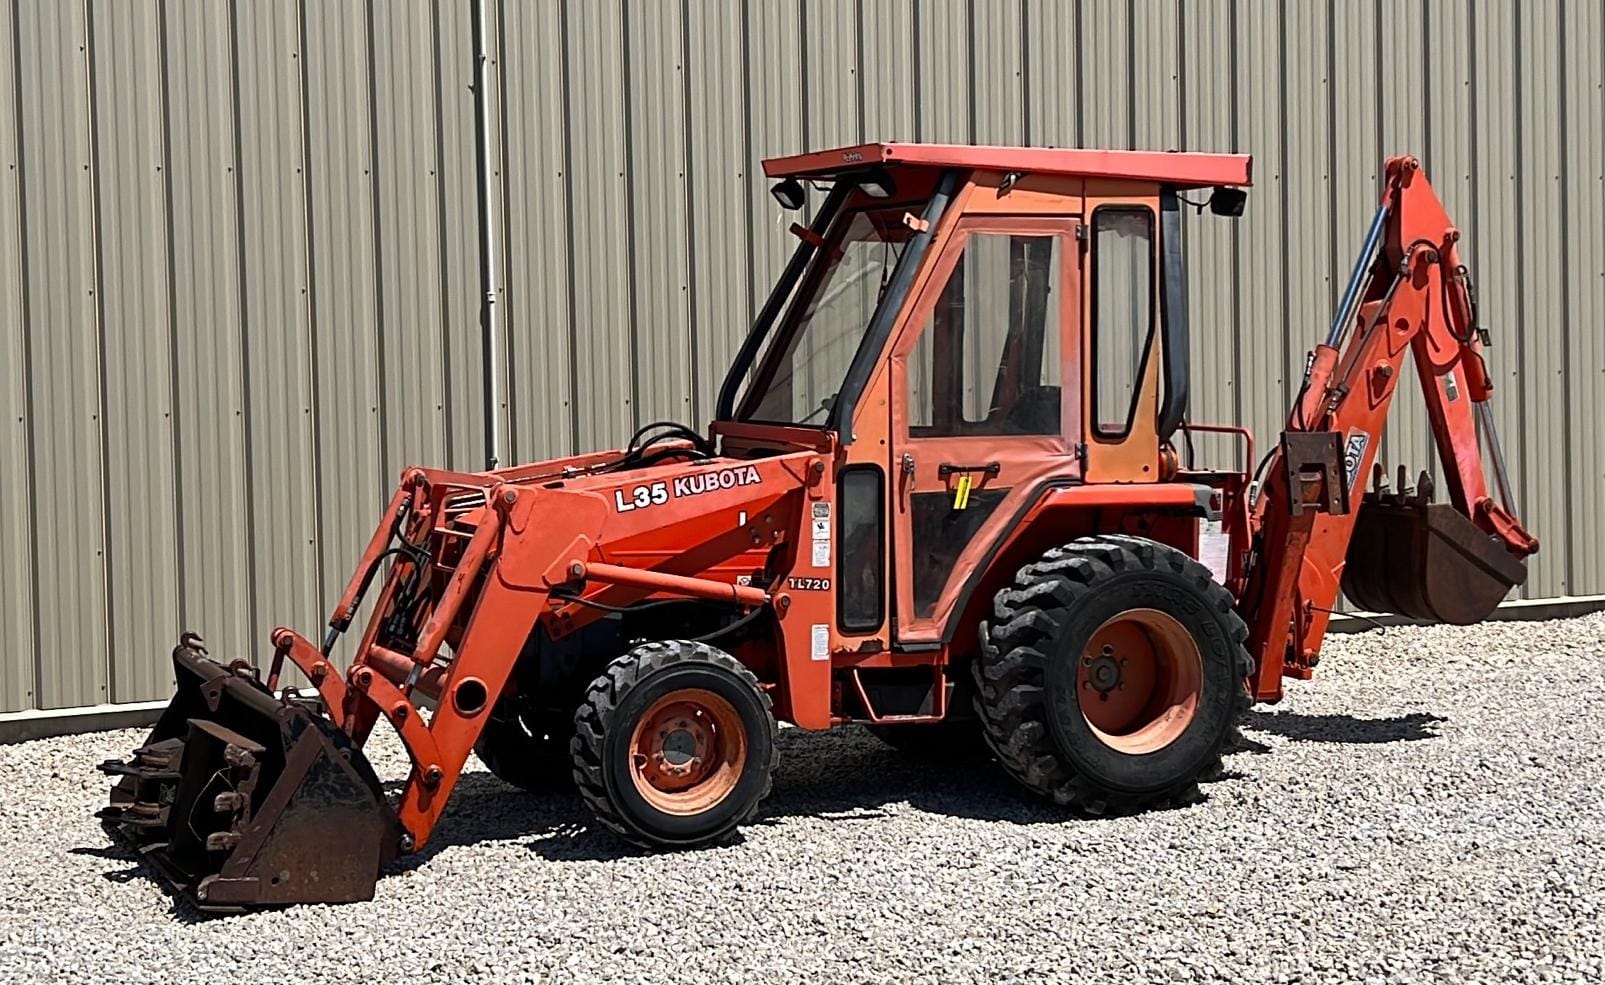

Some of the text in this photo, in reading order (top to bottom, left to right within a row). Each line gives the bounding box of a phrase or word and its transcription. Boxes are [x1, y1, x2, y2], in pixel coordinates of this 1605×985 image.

[615, 465, 761, 513] L35 KUBOTA
[788, 577, 831, 591] TL720
